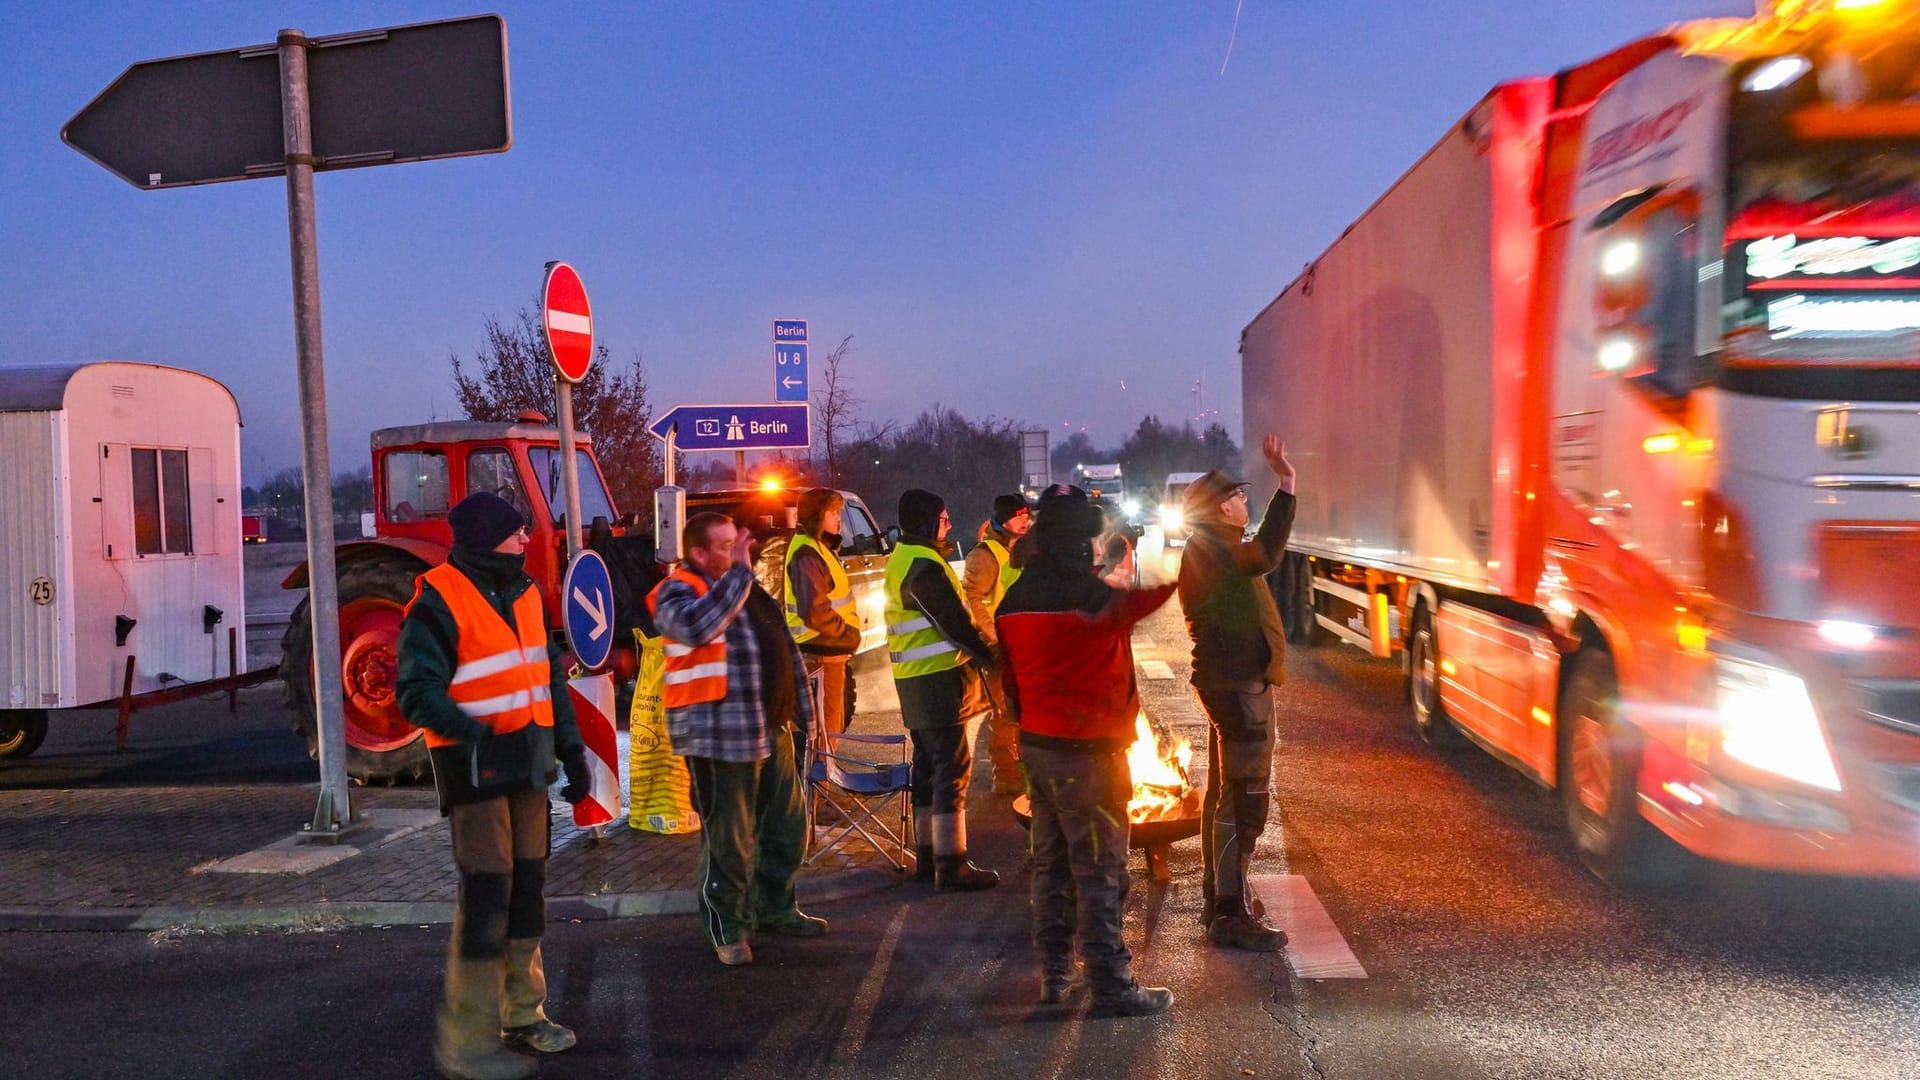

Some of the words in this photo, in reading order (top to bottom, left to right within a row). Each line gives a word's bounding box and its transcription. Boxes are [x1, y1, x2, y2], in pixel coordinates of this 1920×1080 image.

[777, 325, 805, 336] Berlin
[778, 351, 787, 365] U
[793, 352, 801, 365] 8
[703, 422, 713, 433] 12
[750, 421, 788, 434] Berlin
[33, 582, 50, 600] 25
